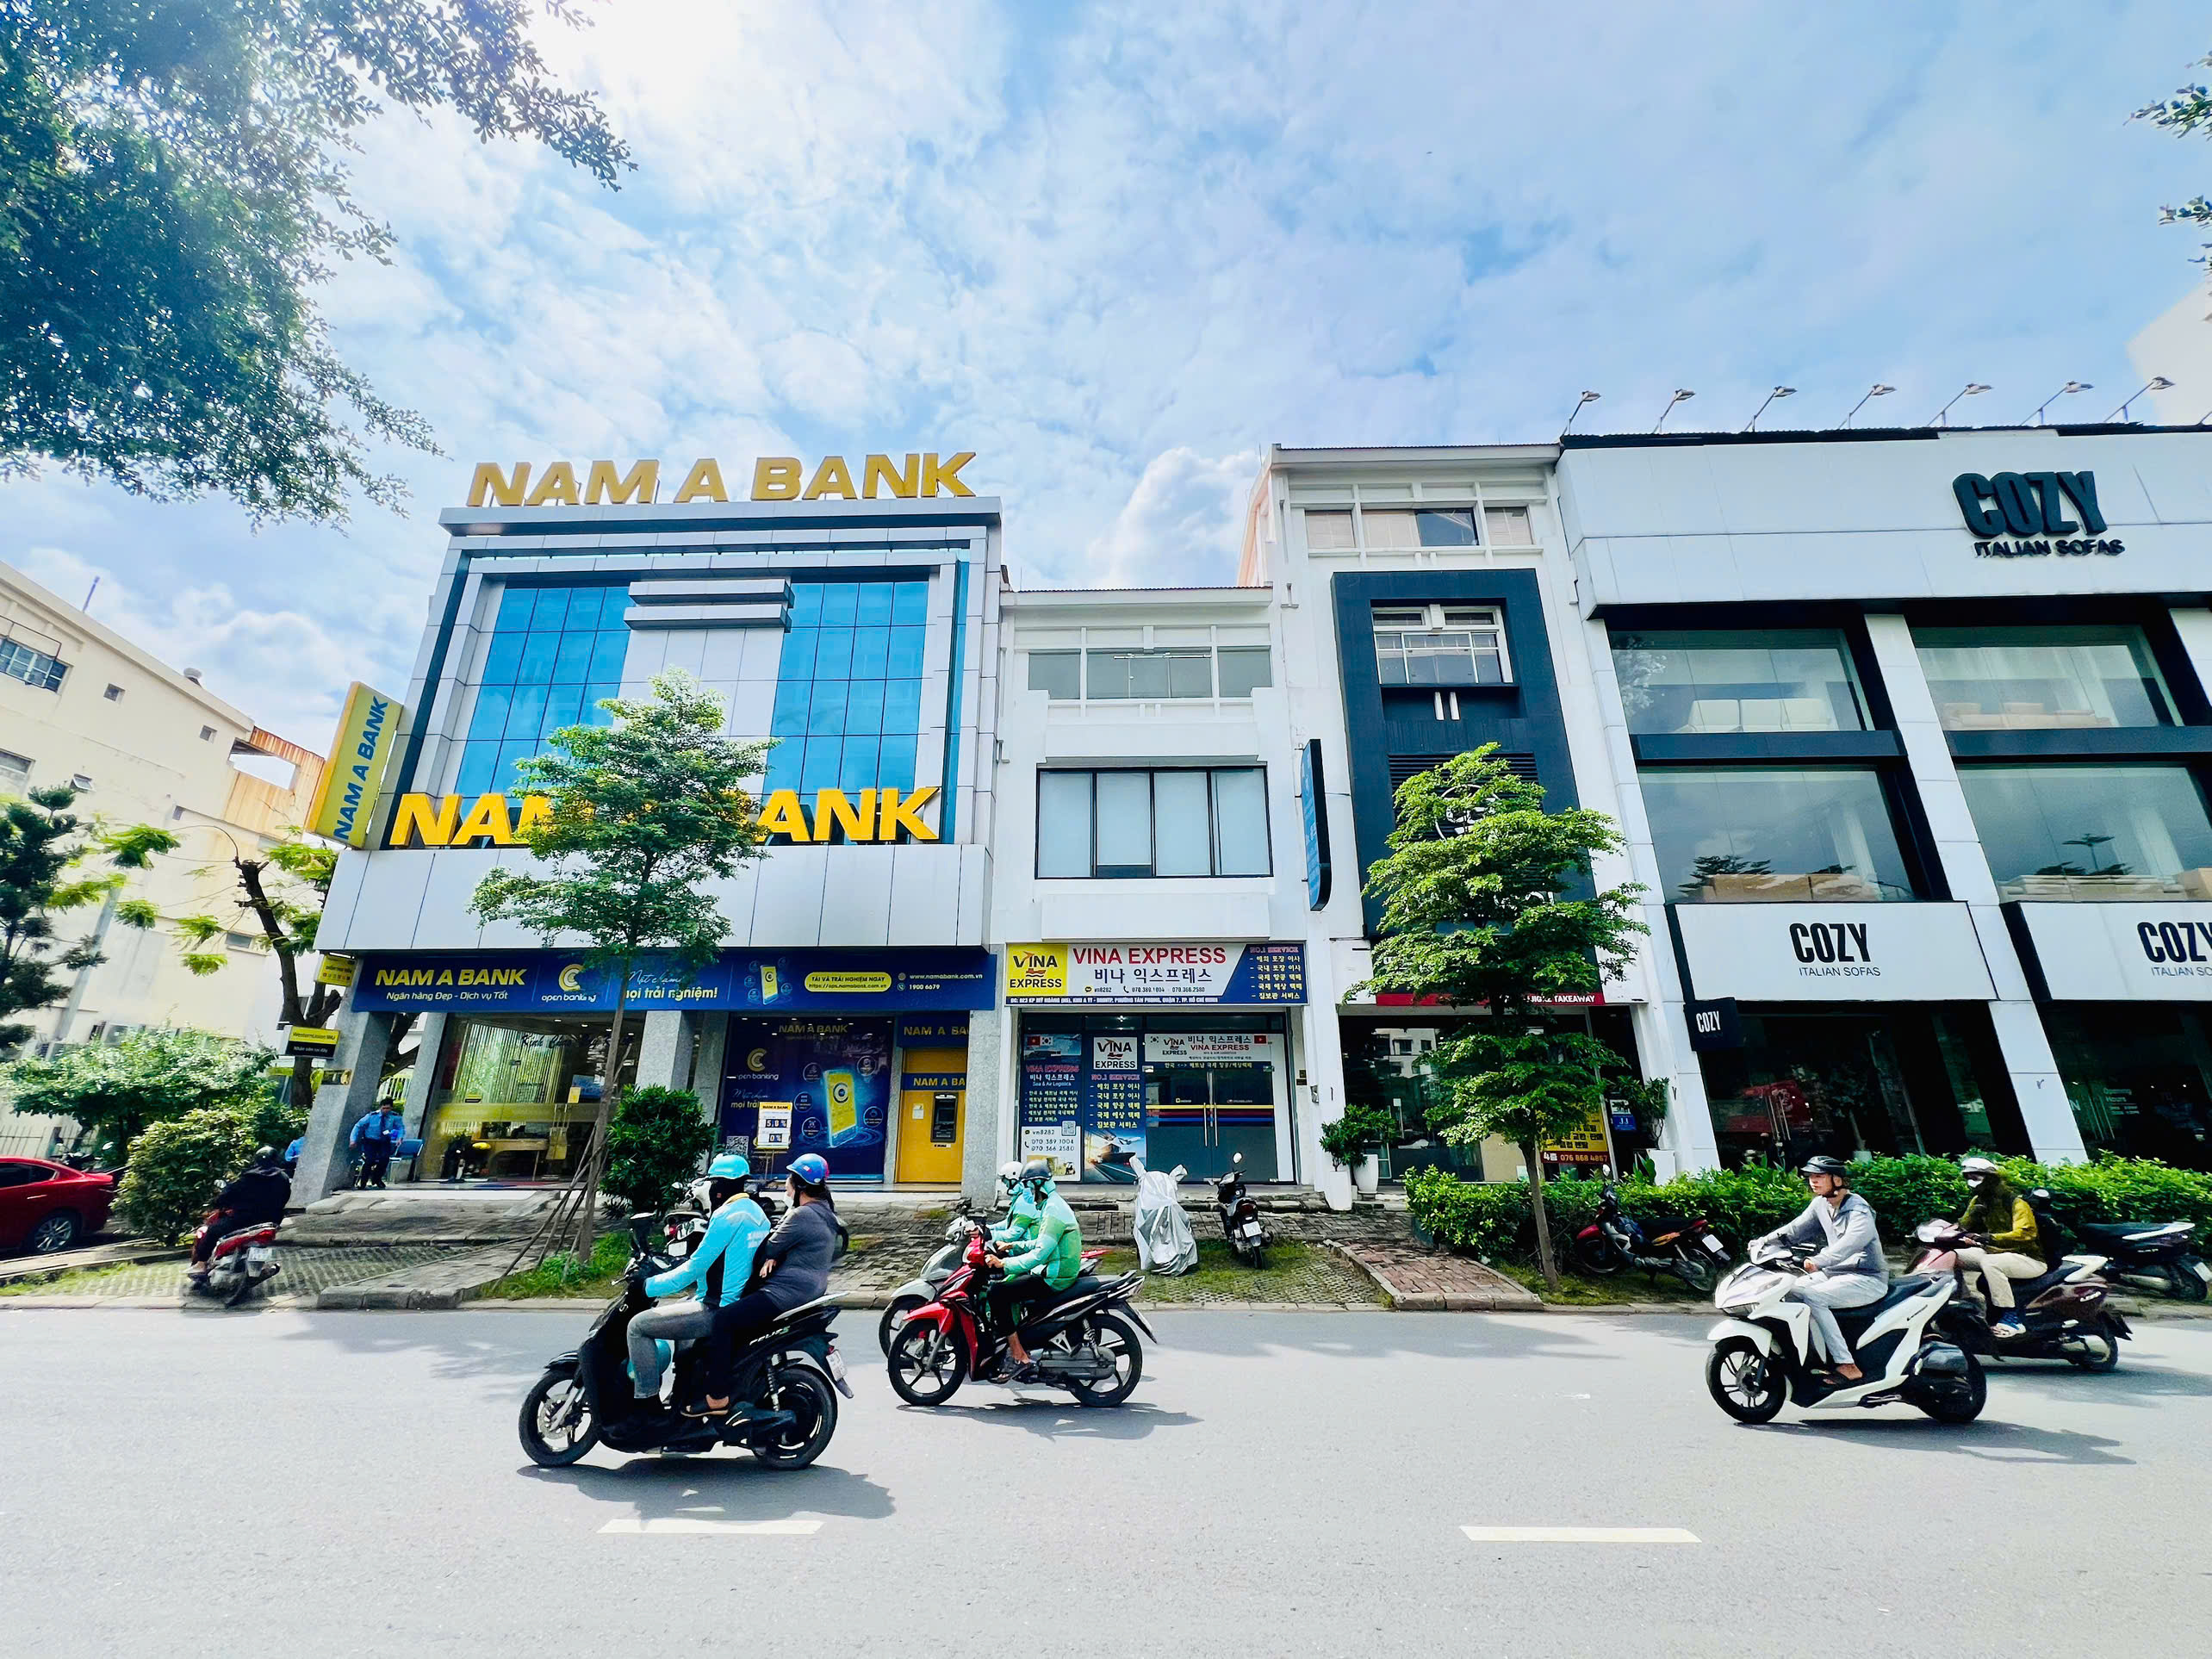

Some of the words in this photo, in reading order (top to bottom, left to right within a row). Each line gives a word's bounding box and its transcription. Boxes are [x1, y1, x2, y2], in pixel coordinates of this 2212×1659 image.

[467, 458, 660, 506] NAM
[674, 457, 730, 504] A
[751, 452, 977, 501] BANK
[1953, 470, 2108, 538] COZY
[1973, 539, 2052, 558] ITALIAN
[2055, 538, 2126, 556] SOFAS
[357, 696, 388, 761] BANK
[352, 765, 370, 782] A
[333, 782, 363, 840] NAM
[1789, 923, 1871, 963] COZY
[1013, 954, 1058, 967] VINA
[1073, 948, 1122, 964] VINA
[1128, 948, 1227, 964] EXPRESS
[375, 969, 434, 986] NAM
[436, 969, 454, 986] A
[457, 968, 528, 986] BANK
[1095, 968, 1125, 984] 비나
[1134, 968, 1212, 984] 익스프레스
[1799, 966, 1841, 977] ITALIAN
[1843, 966, 1881, 977] SOFAS
[2151, 966, 2195, 977] ITALIAN
[644, 985, 665, 998] trải
[1010, 979, 1062, 988] EXPRESS
[386, 991, 411, 1001] Ngân
[412, 991, 434, 1001] hàng
[435, 991, 453, 1001] Đẹp
[460, 991, 480, 1001] Dịch
[494, 989, 508, 1000] Tốt
[779, 1024, 805, 1033] NAM
[817, 1024, 848, 1033] BANK
[1696, 1010, 1721, 1033] COZY
[904, 1026, 932, 1035] NAM
[937, 1026, 946, 1035] A
[951, 1026, 969, 1035] BA
[1097, 1039, 1133, 1053] VINA
[913, 1078, 938, 1086] NAM
[941, 1078, 948, 1086] A
